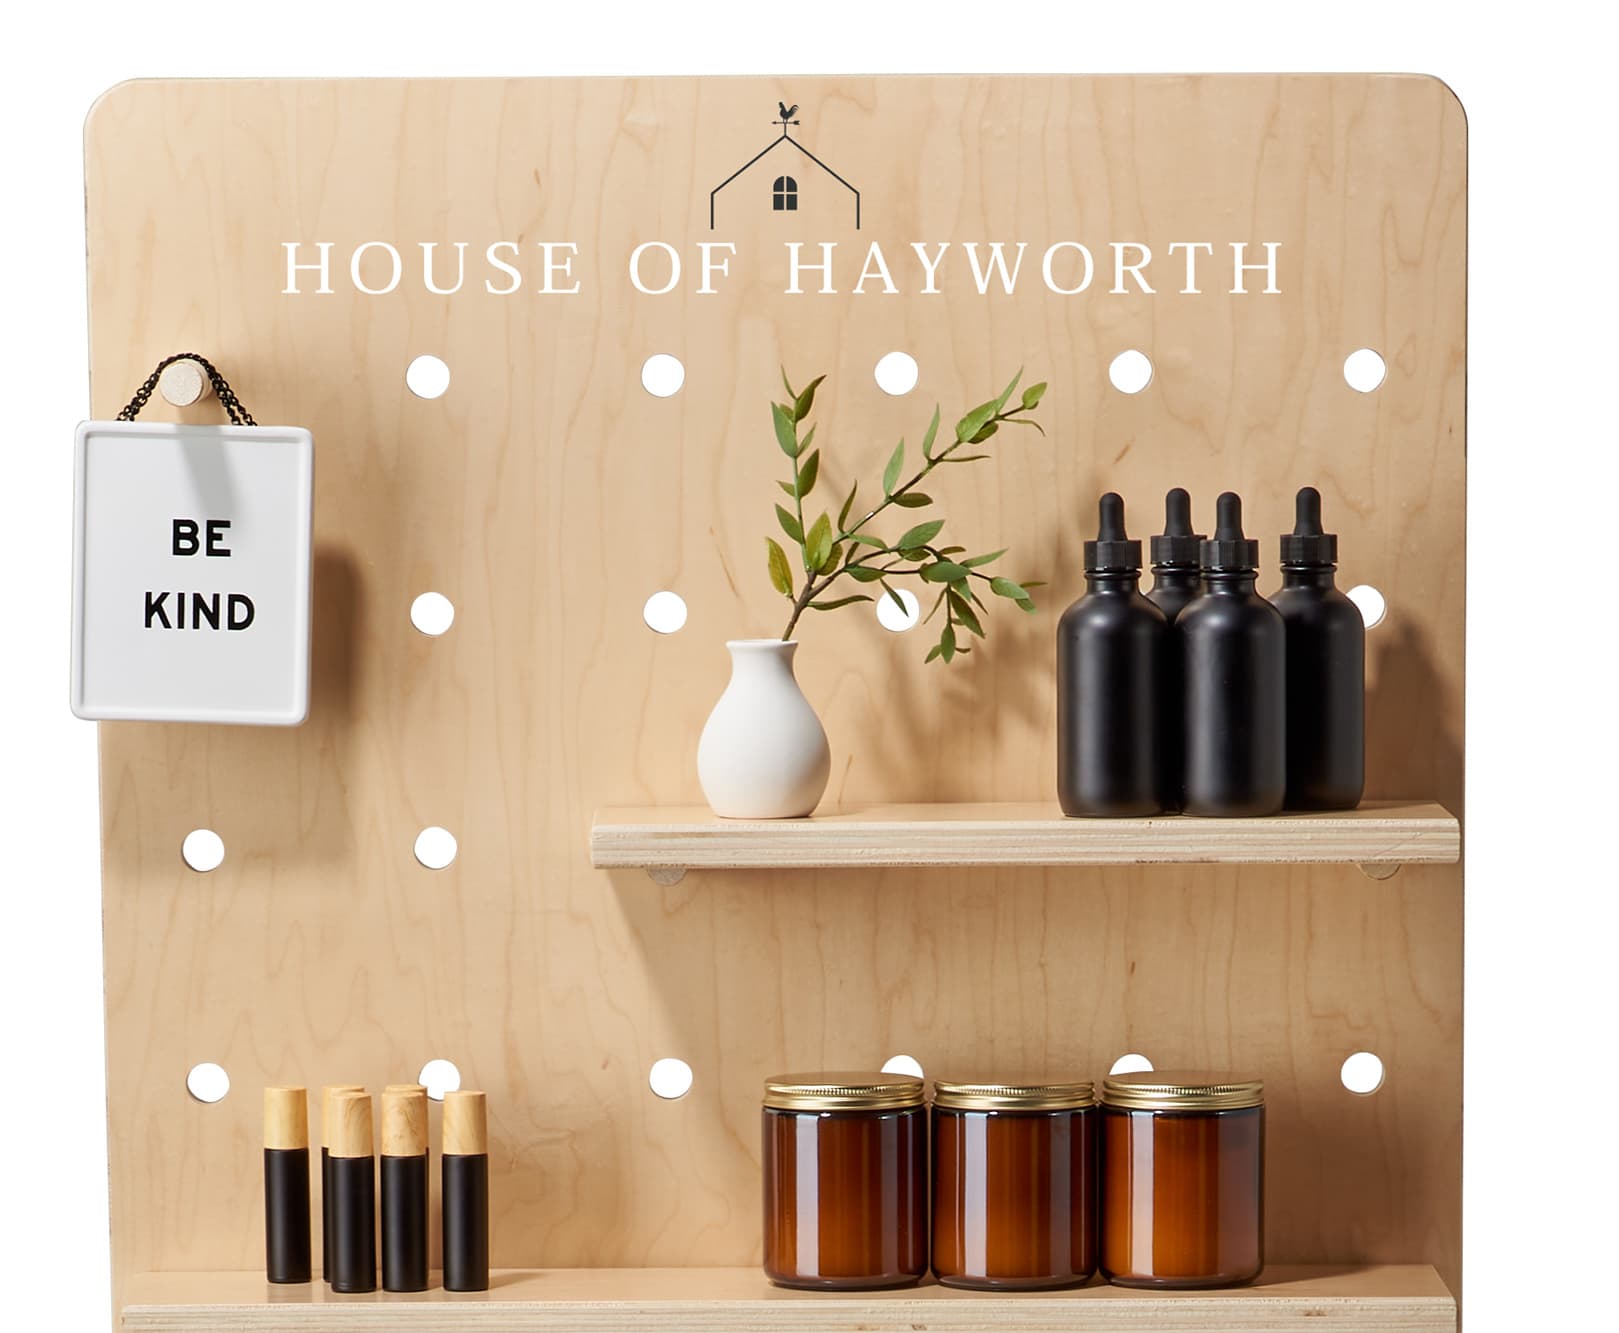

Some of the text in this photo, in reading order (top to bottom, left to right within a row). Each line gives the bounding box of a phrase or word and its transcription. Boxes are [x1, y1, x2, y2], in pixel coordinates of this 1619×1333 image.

[281, 241, 1282, 295] HOUSE OF HAYWORTH
[172, 519, 231, 556] BE
[144, 592, 255, 630] KIND
